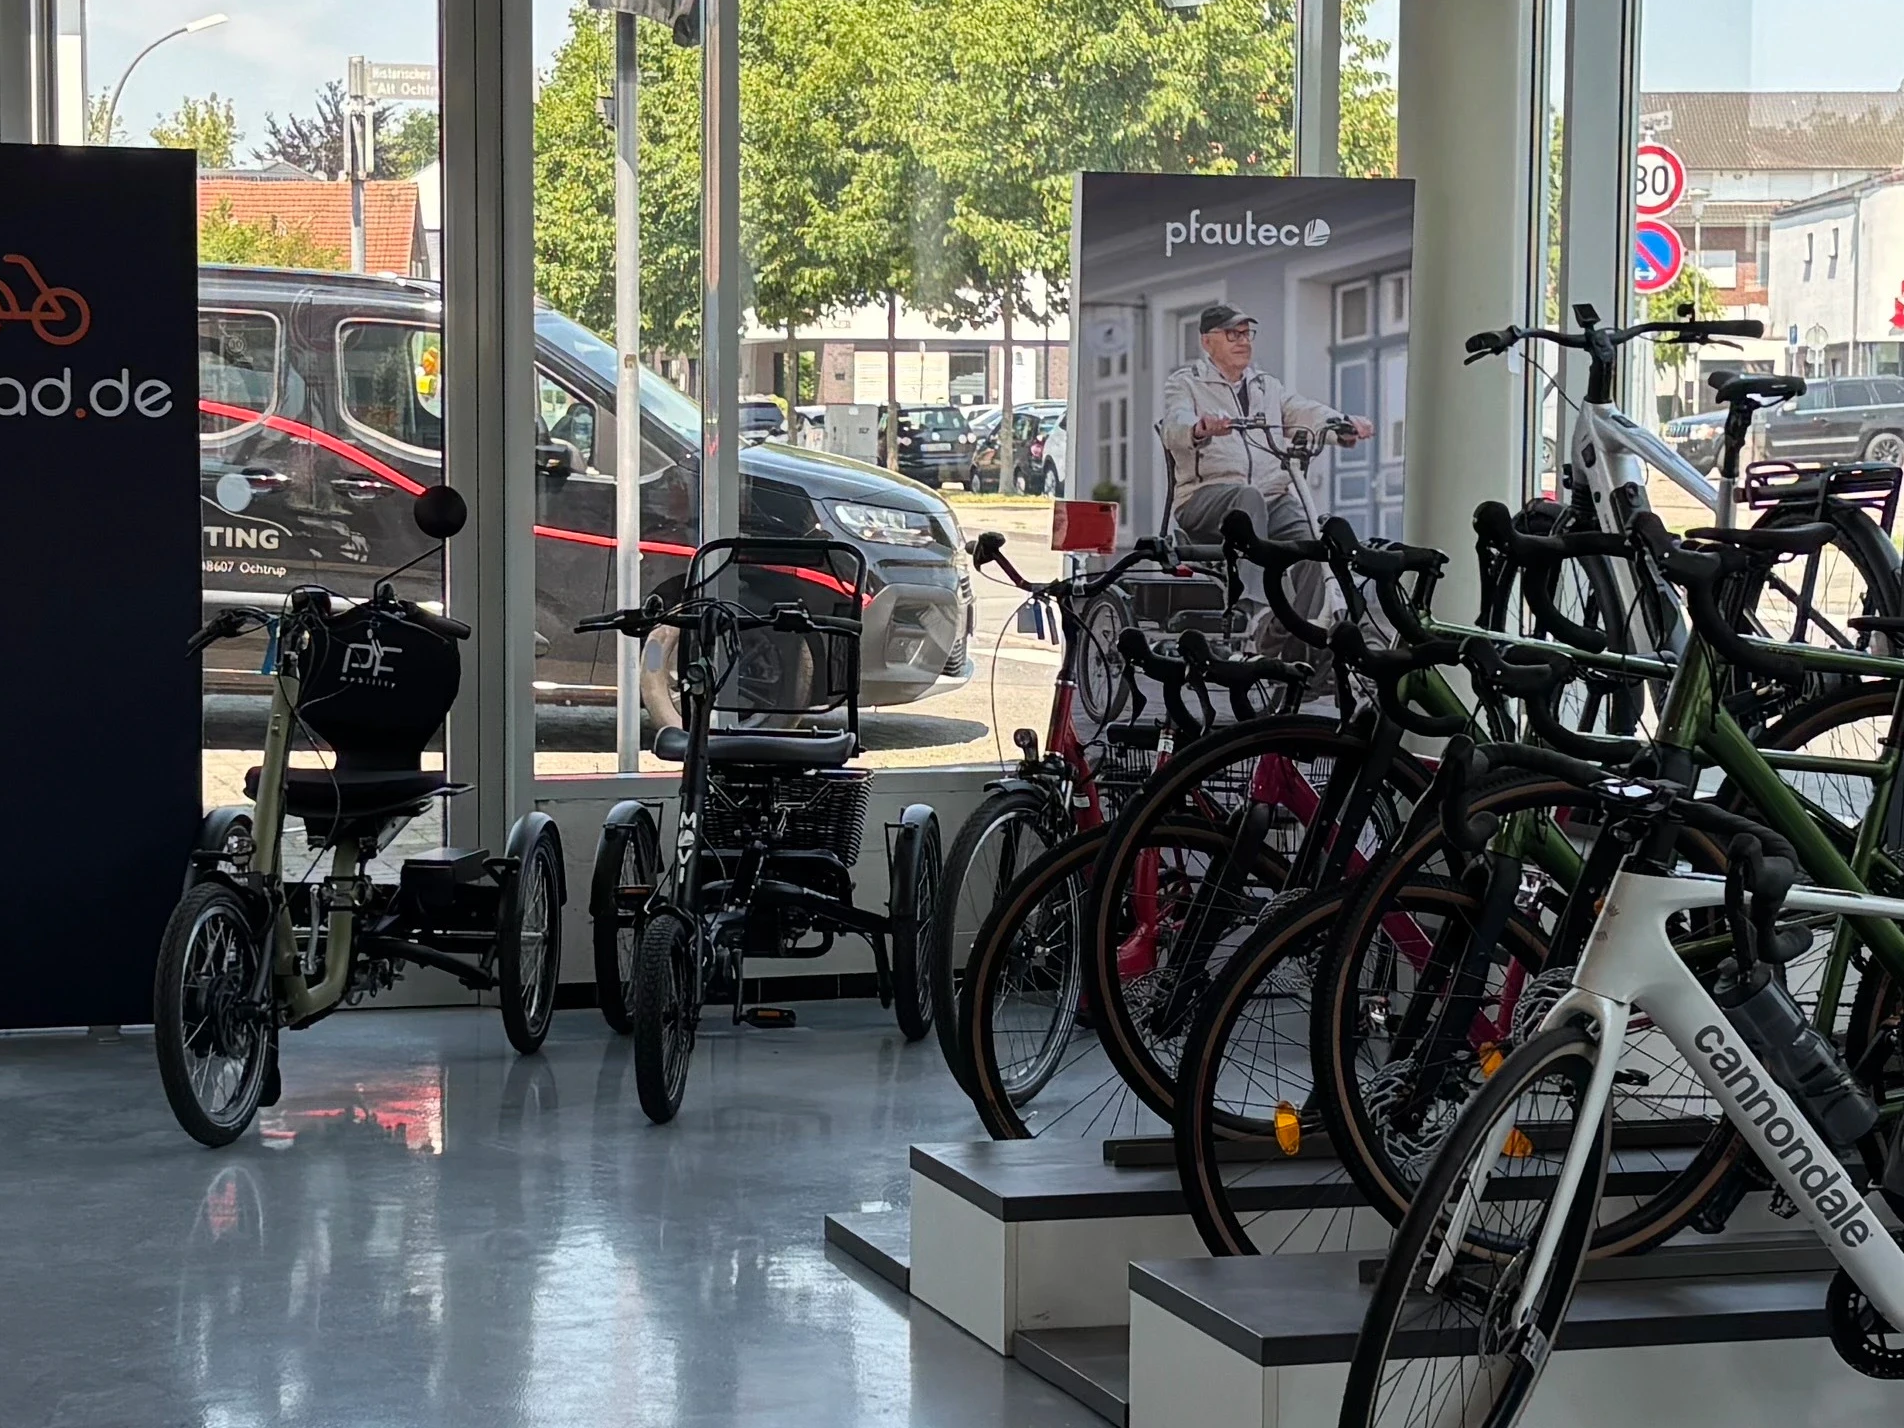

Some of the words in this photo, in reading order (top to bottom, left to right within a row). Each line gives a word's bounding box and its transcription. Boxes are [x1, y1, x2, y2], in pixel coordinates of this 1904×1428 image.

[1166, 209, 1300, 257] pfautec
[239, 561, 287, 578] Ochtrup
[1694, 1025, 1869, 1248] cannondale
